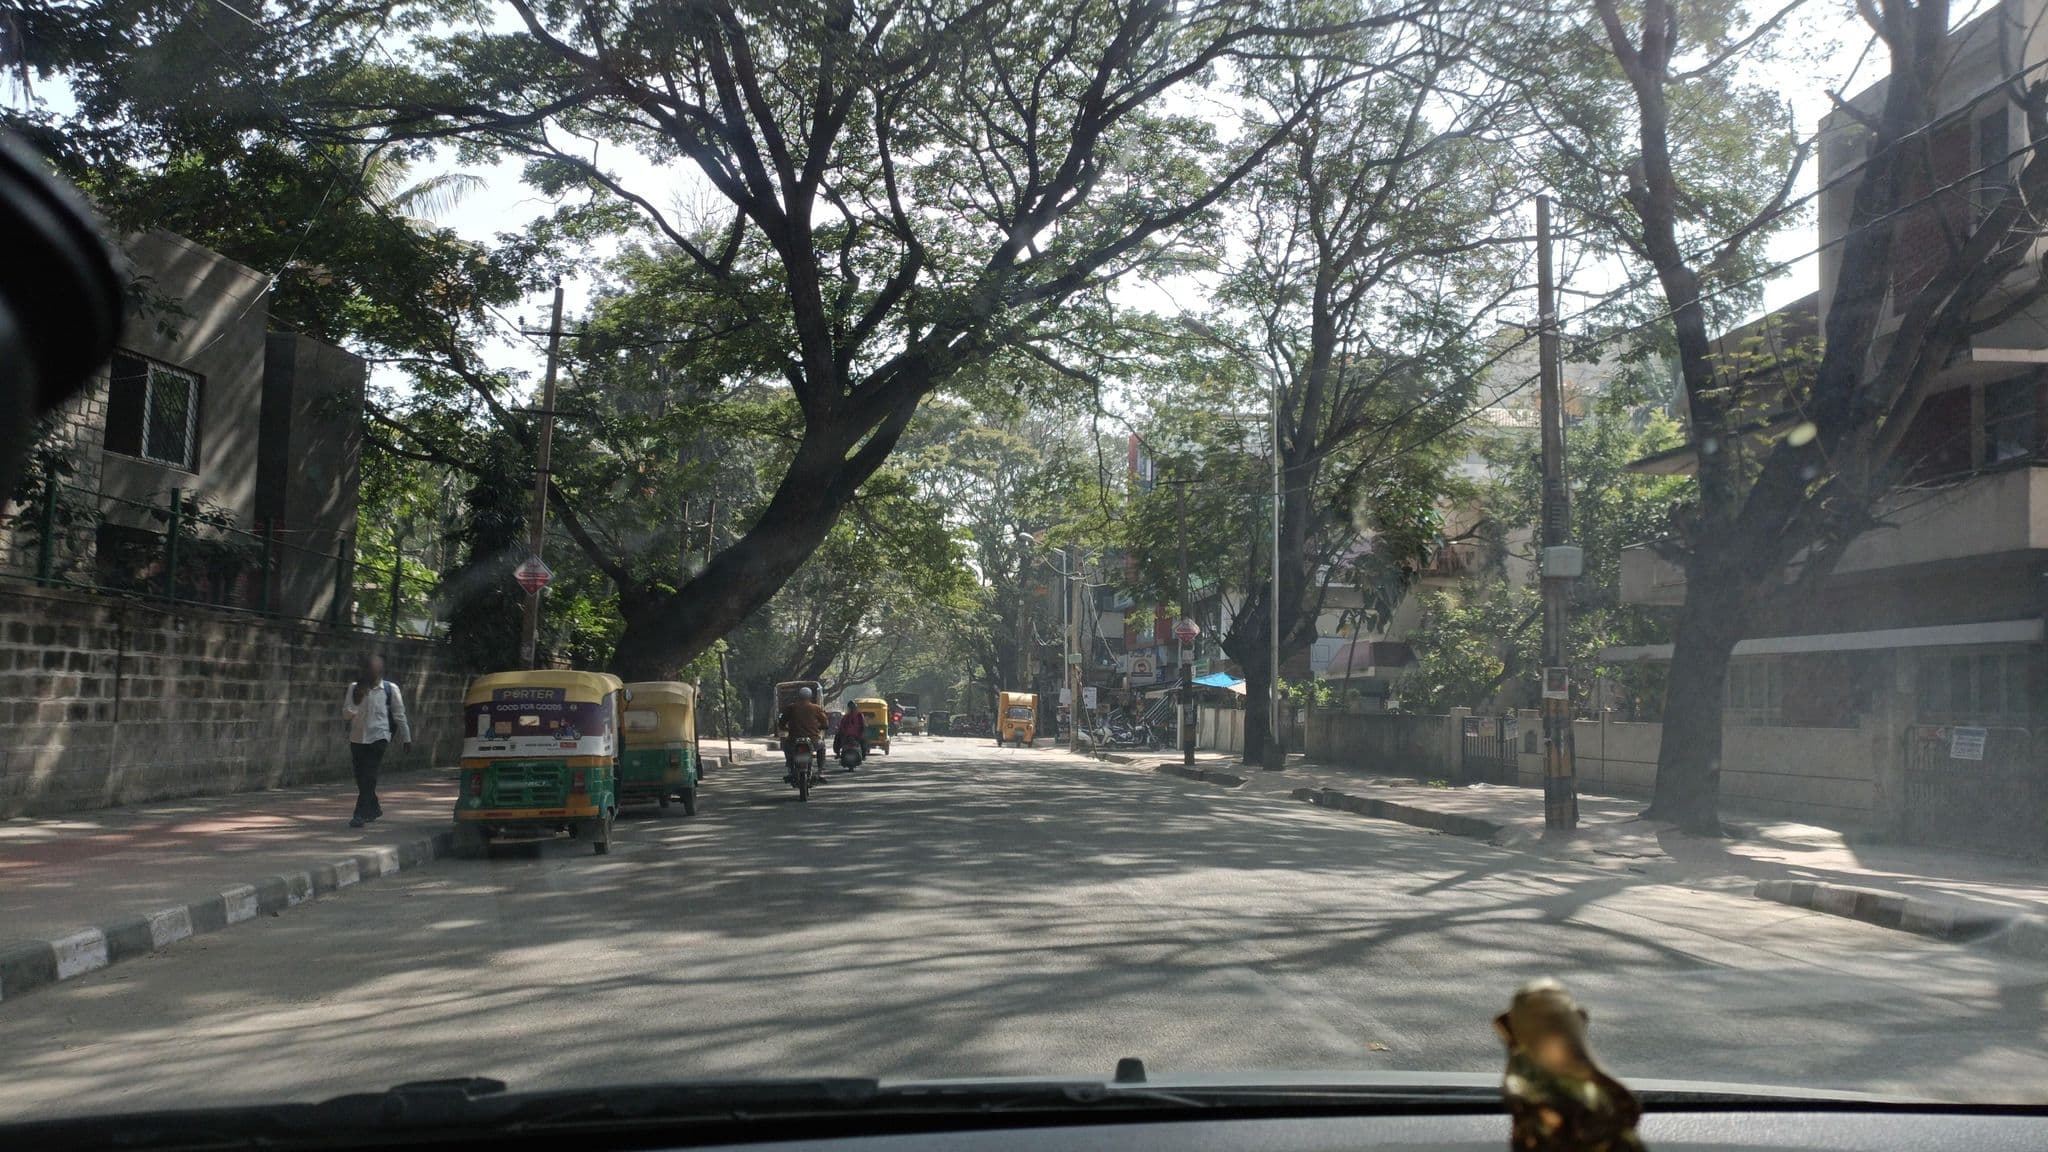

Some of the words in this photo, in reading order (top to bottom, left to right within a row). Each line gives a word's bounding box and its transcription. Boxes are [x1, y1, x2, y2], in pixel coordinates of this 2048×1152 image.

[503, 689, 555, 699] PORTER
[496, 703, 519, 711] GOOD
[520, 703, 534, 711] FOR
[535, 703, 562, 711] GOODS
